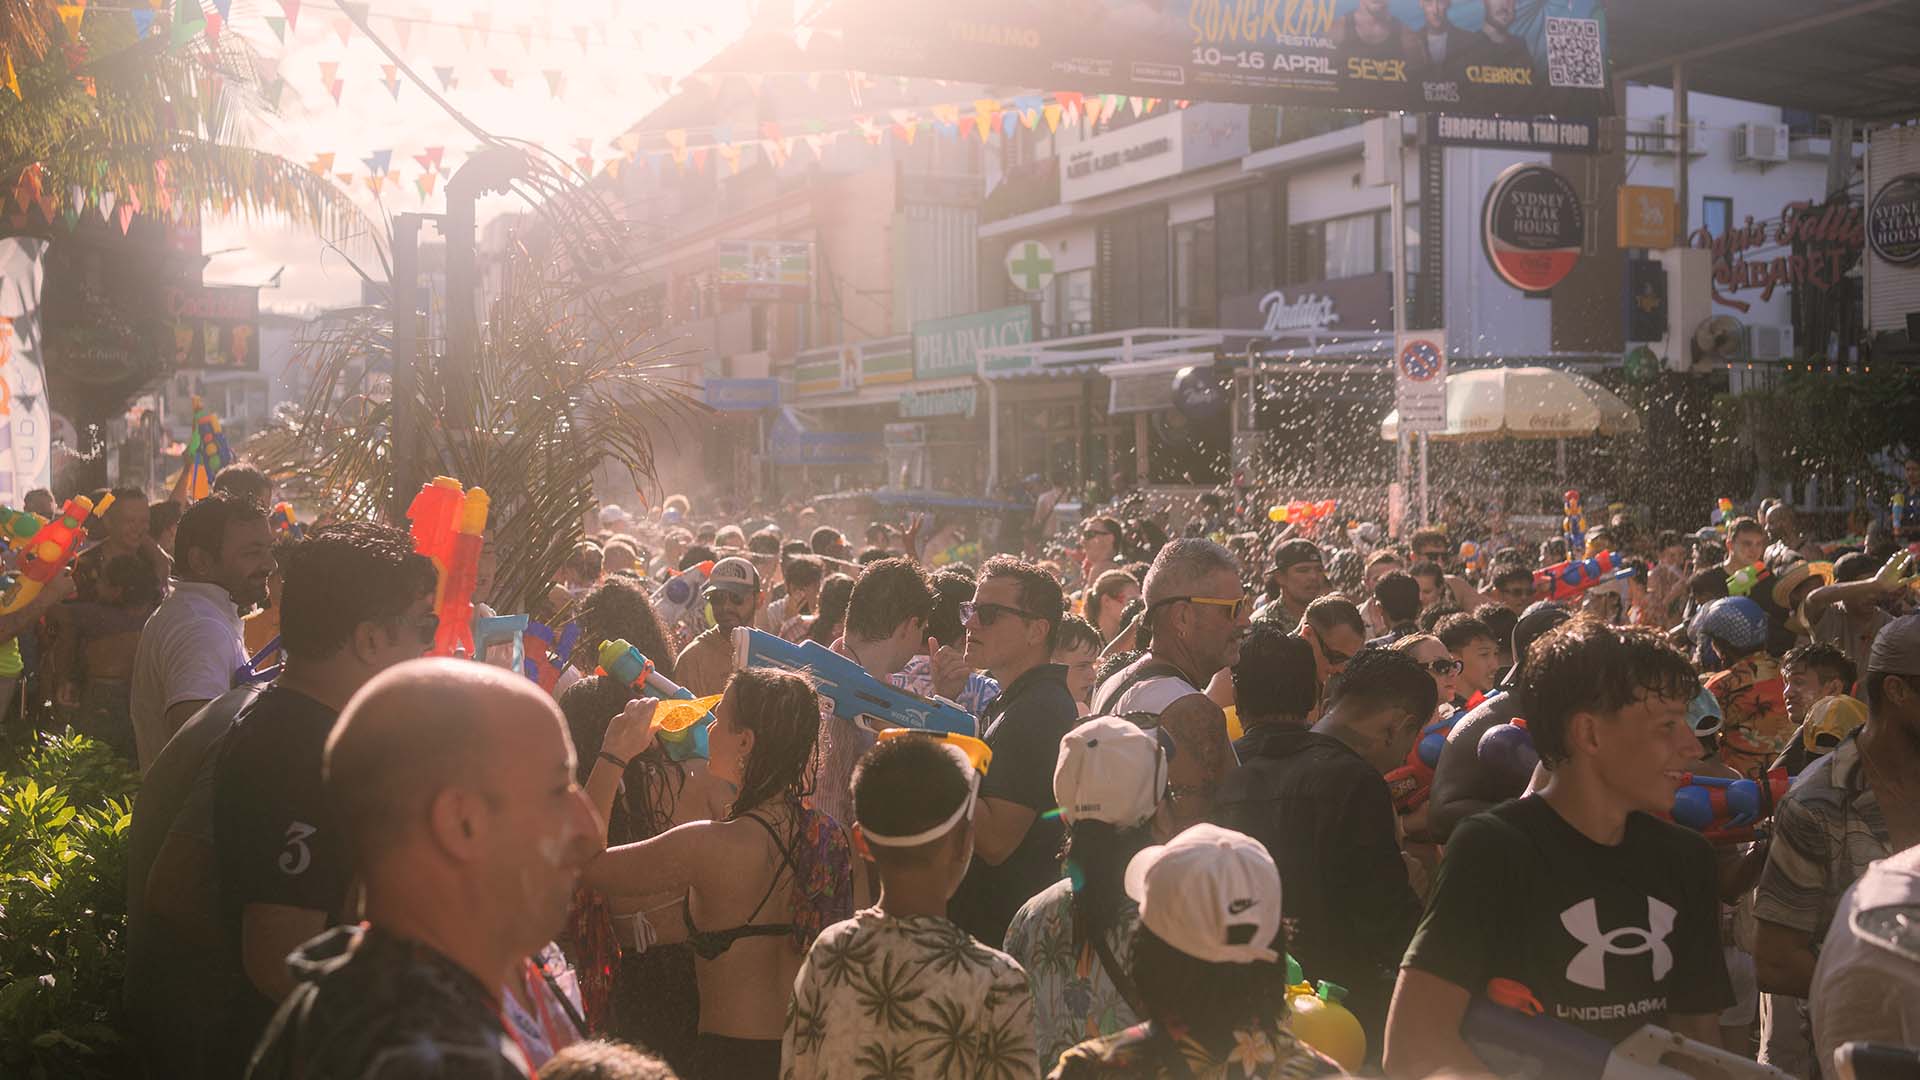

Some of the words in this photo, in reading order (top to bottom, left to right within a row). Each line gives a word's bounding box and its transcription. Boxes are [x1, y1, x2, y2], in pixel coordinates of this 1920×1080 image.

[1275, 33, 1337, 50] FESTIVAL
[1273, 53, 1338, 75] APRIL
[1438, 117, 1497, 140] EUROPEAN
[1532, 123, 1558, 144] THAI
[1560, 125, 1589, 146] FOOD
[1511, 190, 1563, 208] SYDNEY
[1514, 204, 1559, 220] STEAK
[1876, 200, 1920, 219] SYDNE
[1513, 219, 1561, 235] HOUSE
[279, 821, 317, 875] 3
